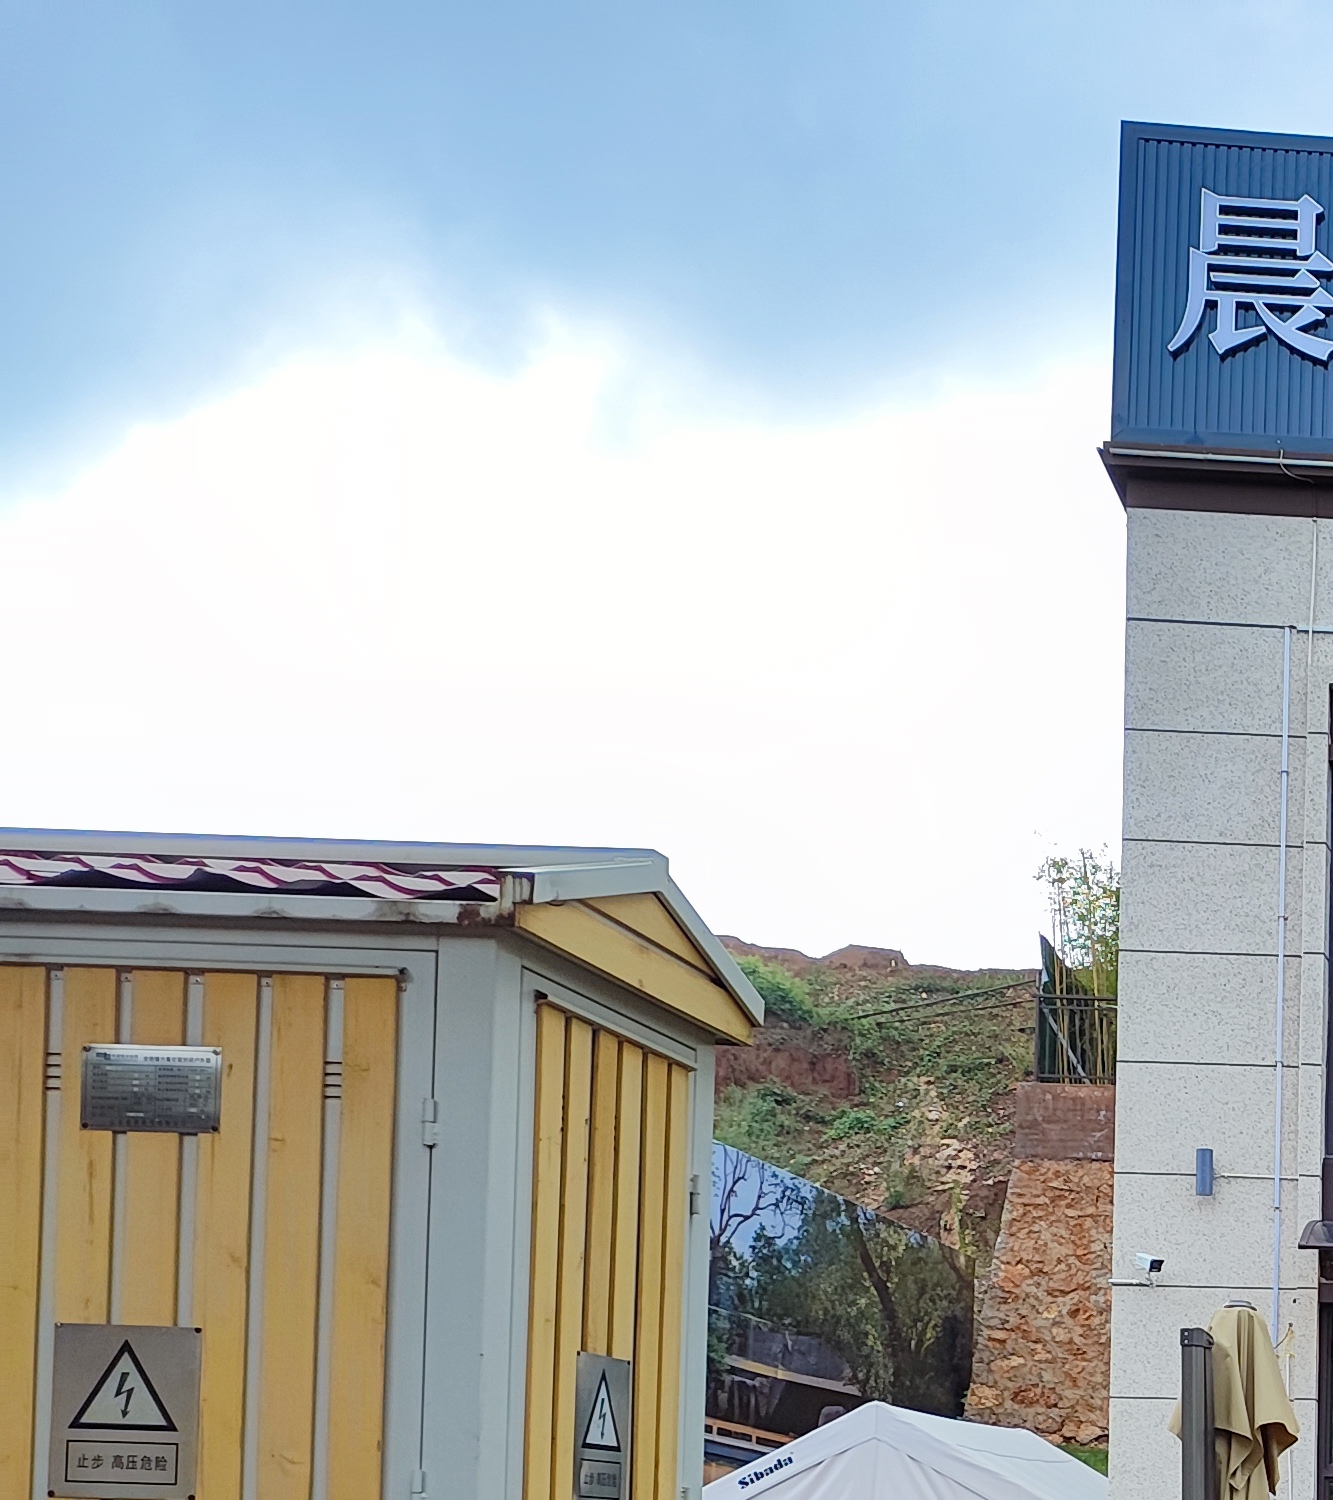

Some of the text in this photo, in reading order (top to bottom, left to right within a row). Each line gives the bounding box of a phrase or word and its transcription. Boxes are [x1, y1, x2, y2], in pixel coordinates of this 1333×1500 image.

[77, 1453, 168, 1471] 止步 高压危险
[738, 1456, 794, 1490] Sibada
